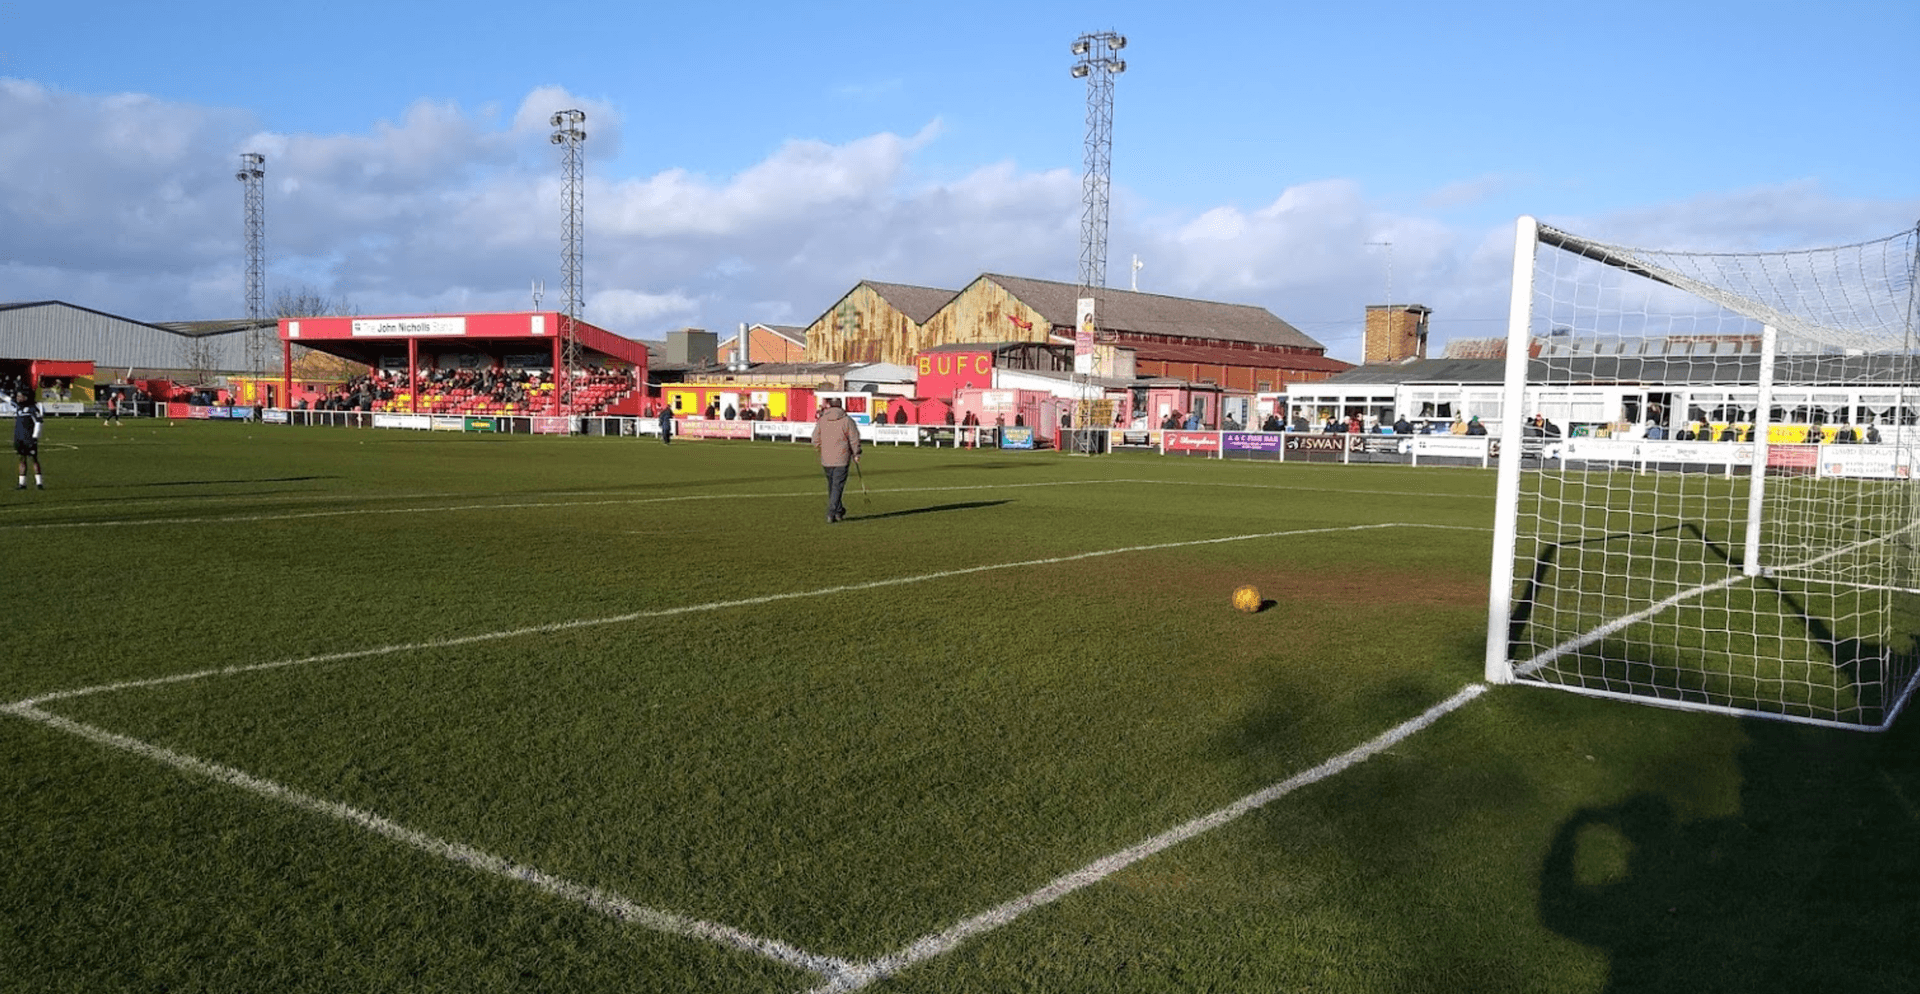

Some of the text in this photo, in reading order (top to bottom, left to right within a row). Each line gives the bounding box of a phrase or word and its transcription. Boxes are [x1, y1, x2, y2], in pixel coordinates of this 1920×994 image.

[377, 322, 397, 333] John
[398, 322, 431, 333] Nicholls
[919, 355, 989, 375] BUFC
[1306, 438, 1343, 450] SWAN
